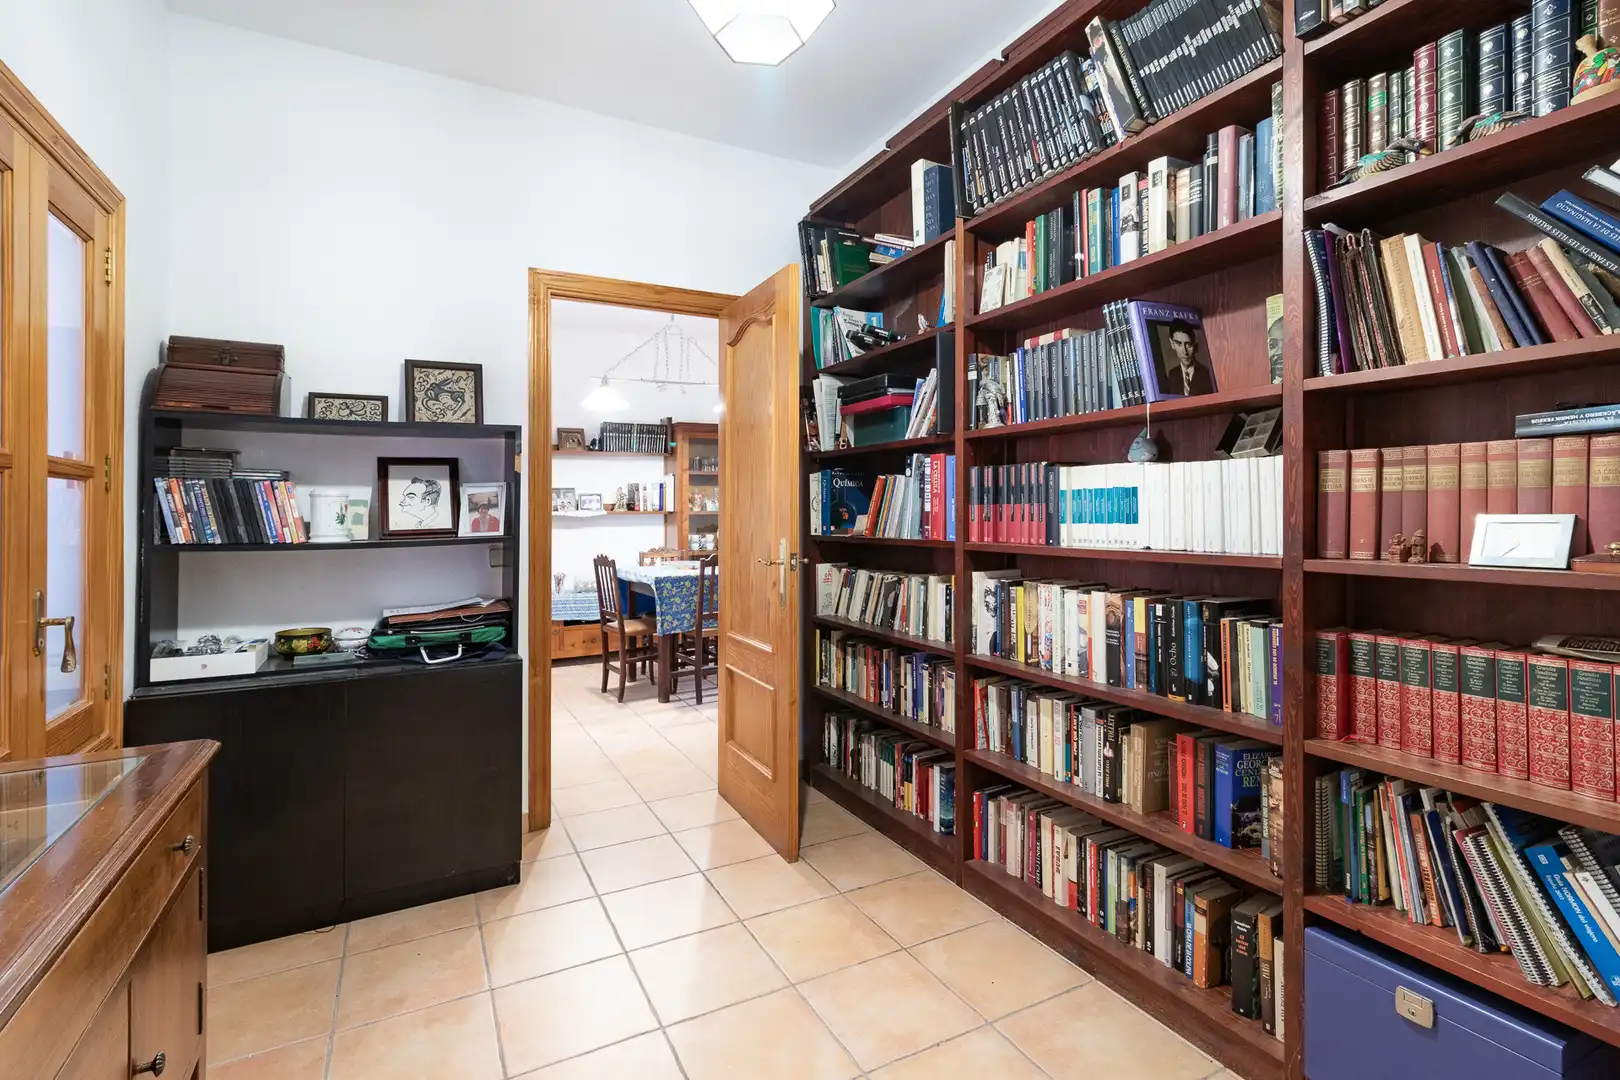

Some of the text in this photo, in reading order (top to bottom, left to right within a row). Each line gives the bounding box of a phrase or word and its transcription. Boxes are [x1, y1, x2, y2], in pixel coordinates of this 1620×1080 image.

[1593, 222, 1601, 230] LA
[1526, 213, 1618, 271] ELS FARS DE LES ILLES BALEARS
[1142, 307, 1199, 320] FRANZ KAFKA
[1169, 642, 1177, 666] Ocho
[1561, 886, 1582, 914] NORMON
[1578, 914, 1588, 924] del
[1584, 923, 1599, 943] viajero
